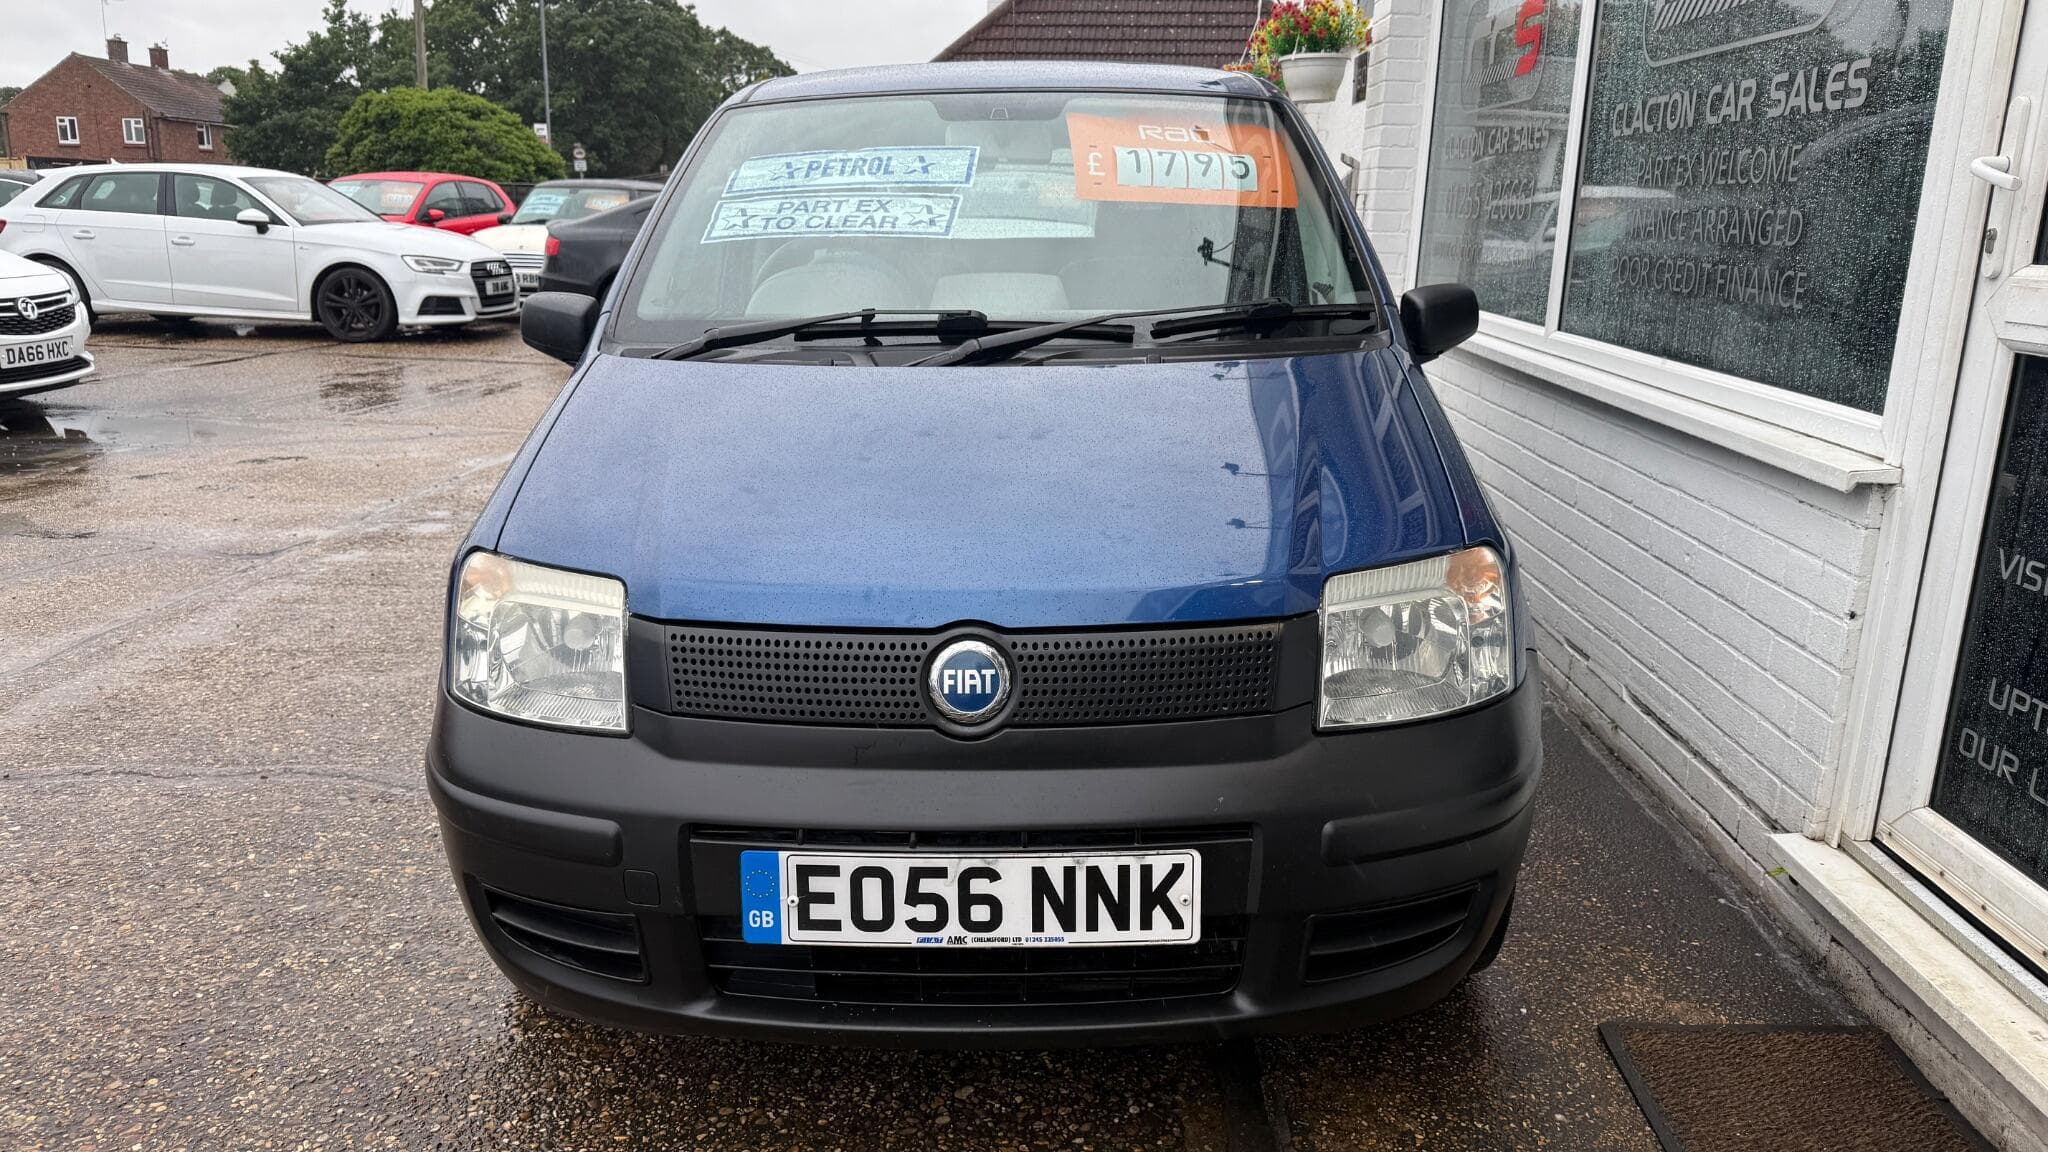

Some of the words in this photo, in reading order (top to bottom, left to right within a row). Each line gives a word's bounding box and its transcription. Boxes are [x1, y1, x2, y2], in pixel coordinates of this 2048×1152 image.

[1613, 88, 1697, 137] CLACTON
[1706, 78, 1757, 124] CAR
[1768, 57, 1873, 118] SALES
[1488, 126, 1510, 154] CAR
[1513, 118, 1550, 153] SALES
[803, 155, 896, 179] PETROL
[1637, 154, 1673, 186] PART
[1676, 151, 1700, 187] EX
[1700, 144, 1799, 188] WELCOME
[759, 216, 797, 231] TO
[803, 214, 899, 230] CLEAR
[775, 199, 846, 214] PART
[854, 199, 892, 213] EX
[1690, 207, 1804, 248] ARRANGED
[1610, 254, 1650, 289] POOR
[1653, 257, 1712, 298] CREDIT
[1713, 262, 1808, 310] FINANCE
[5, 345, 44, 365] DA66
[46, 340, 69, 360] HXC
[943, 669, 996, 694] FIAT
[1959, 727, 2020, 786] OUR
[796, 864, 1003, 934] EO56
[1031, 862, 1187, 933] NNK
[748, 910, 775, 929] GB
